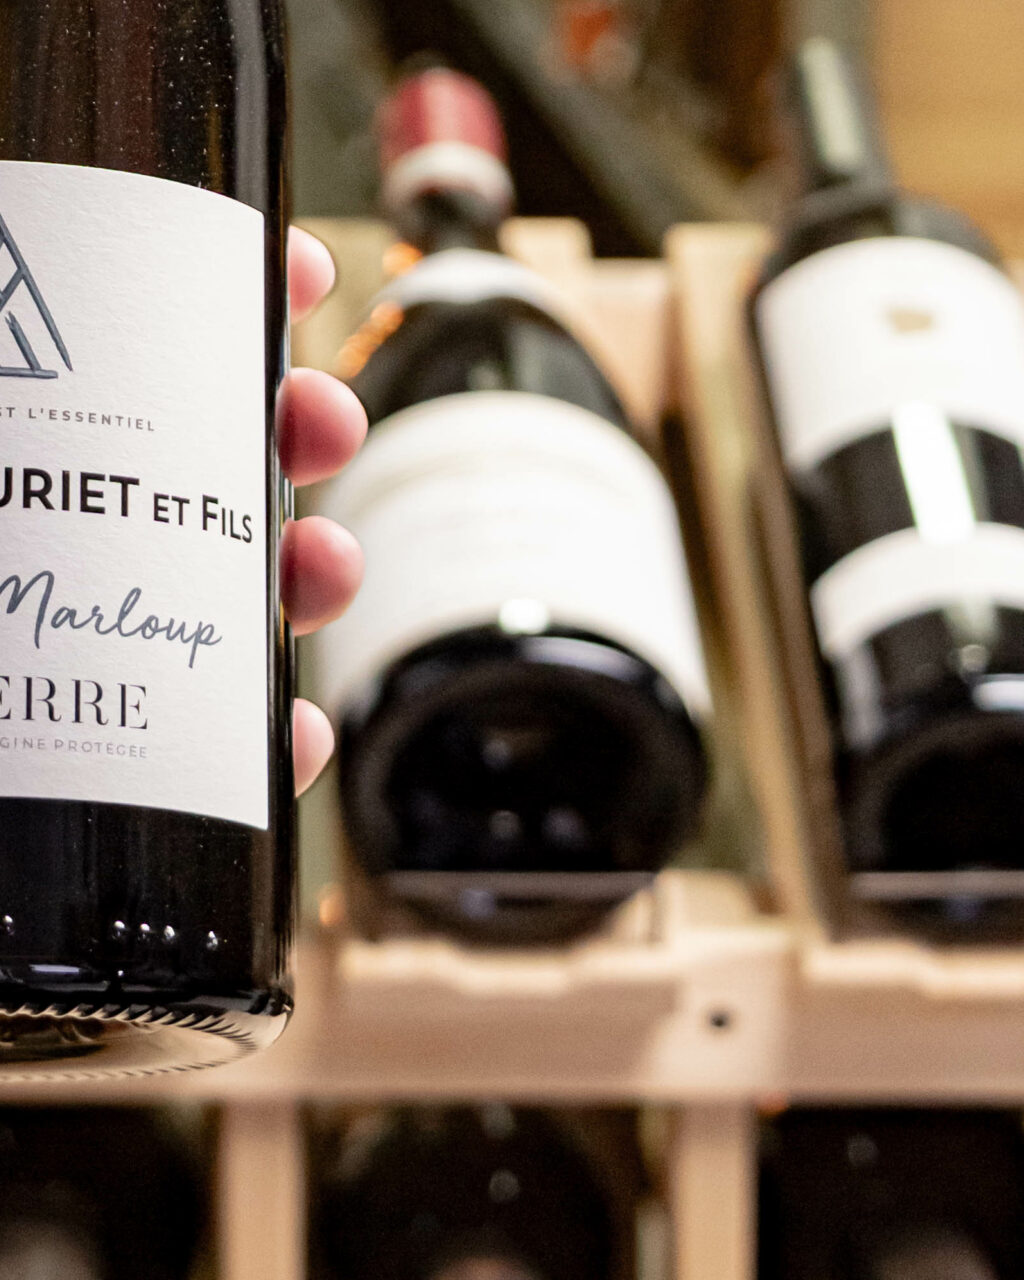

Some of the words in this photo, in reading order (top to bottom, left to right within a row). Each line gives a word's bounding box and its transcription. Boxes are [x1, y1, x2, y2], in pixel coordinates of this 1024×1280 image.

[28, 407, 155, 432] L'ESSENTIEL
[154, 493, 190, 526] ET
[202, 495, 252, 543] FILS
